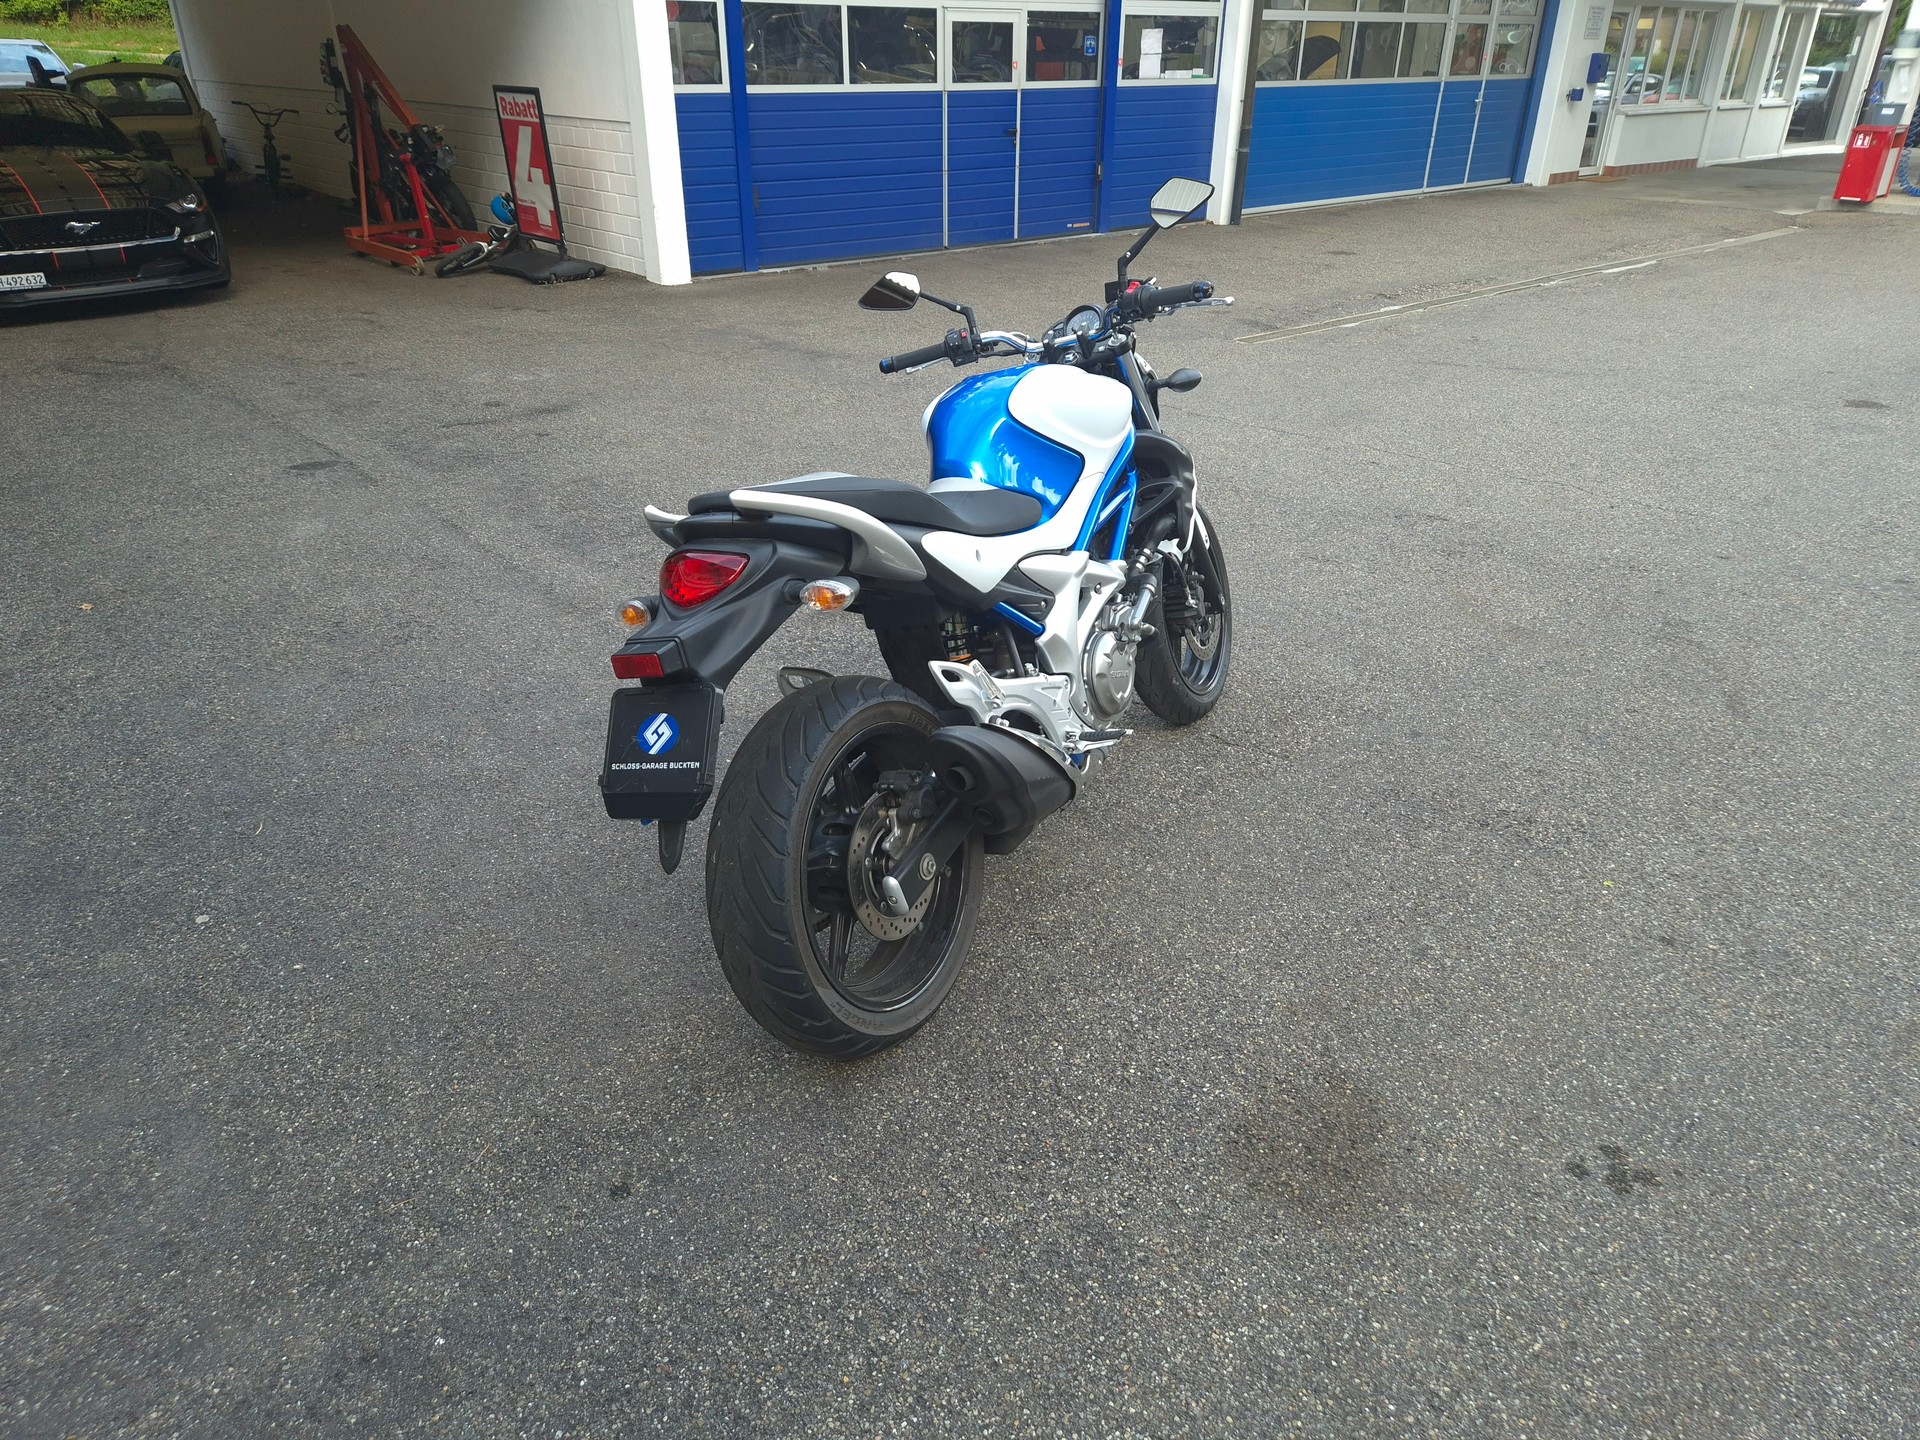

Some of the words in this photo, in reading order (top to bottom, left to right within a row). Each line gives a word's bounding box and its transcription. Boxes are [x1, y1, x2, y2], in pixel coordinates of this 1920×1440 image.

[499, 96, 539, 119] Rabatt
[514, 125, 555, 227] 4
[611, 762, 668, 770] SCHLOSS-GARAGE
[669, 761, 700, 769] BUCKTEN
